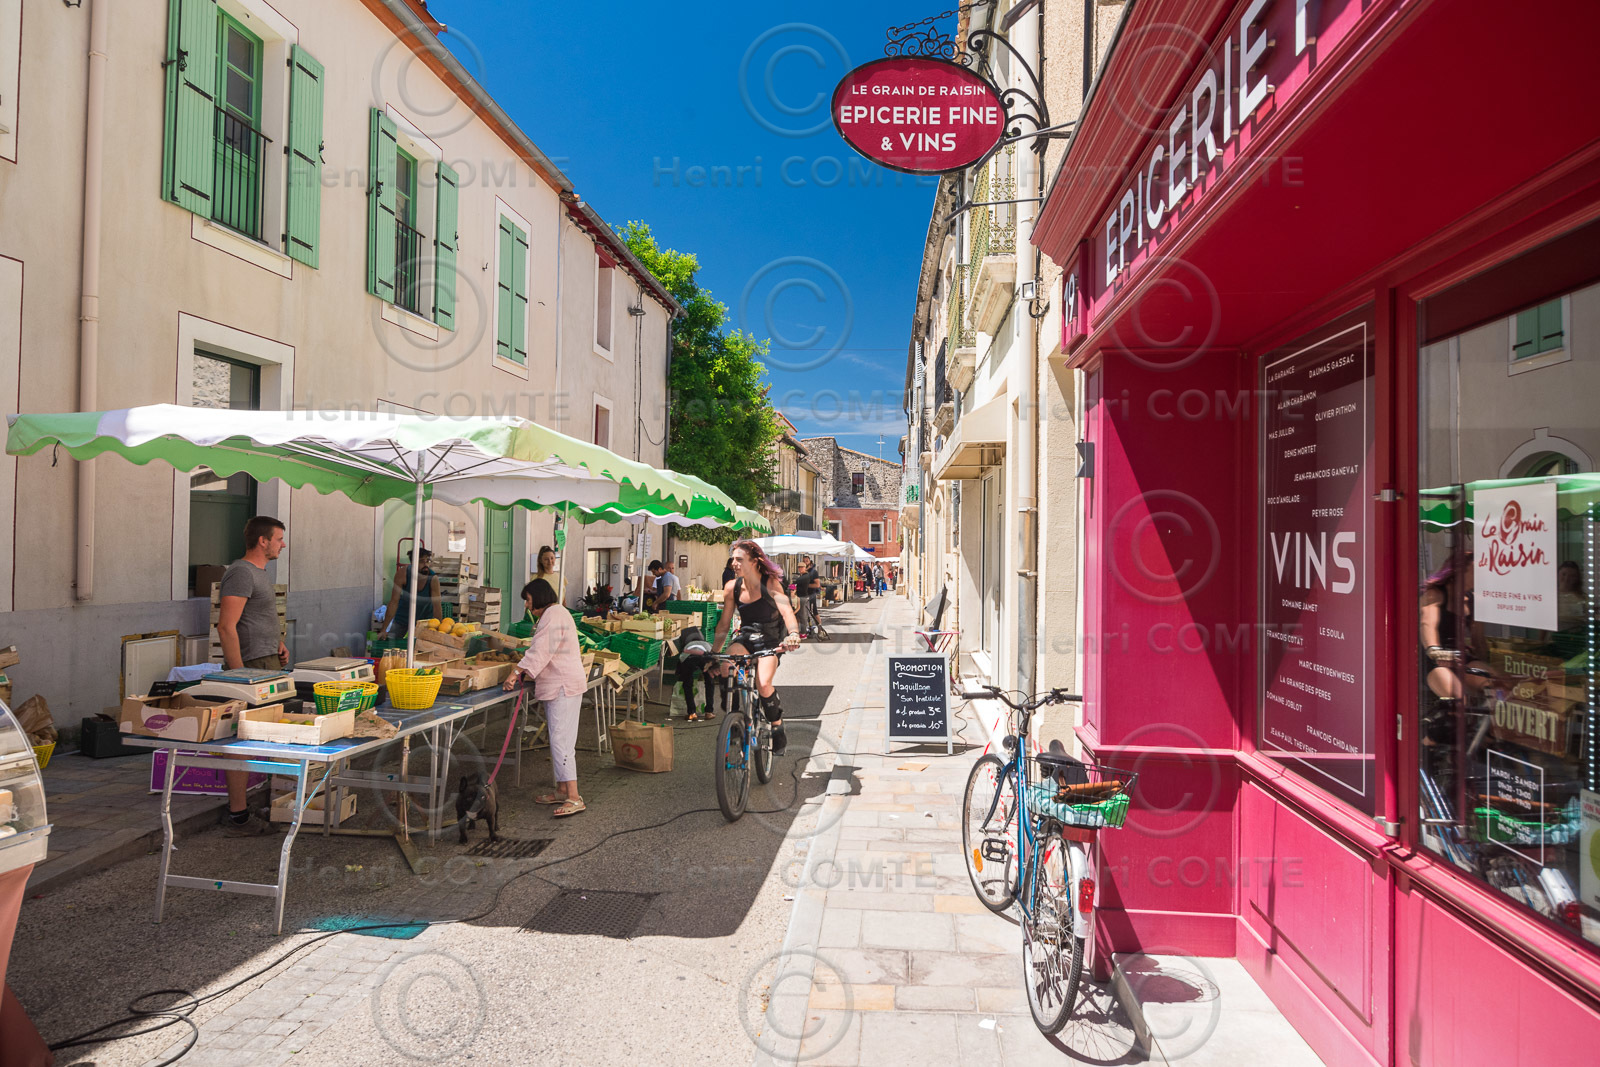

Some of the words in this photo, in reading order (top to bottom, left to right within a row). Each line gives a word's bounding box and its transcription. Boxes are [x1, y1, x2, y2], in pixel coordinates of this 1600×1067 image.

[852, 85, 868, 95] LE
[872, 85, 914, 96] GRAIN
[918, 86, 935, 96] DE
[940, 86, 986, 96] RAISIN
[840, 105, 940, 125] EPICERIE
[950, 106, 997, 125] FINE
[881, 136, 893, 151] &
[899, 132, 956, 152] VINS
[1106, 0, 1267, 286] EPICERIE
[1064, 272, 1076, 328] 19
[1274, 366, 1296, 380] GARANCE
[1308, 363, 1330, 378] DAUMAS
[1331, 354, 1355, 370] GASSAC
[1314, 408, 1334, 422] OLIVIER
[1336, 402, 1356, 416] PITHON
[1268, 430, 1278, 440] MAS
[1284, 448, 1296, 458] DENIS
[1298, 444, 1316, 456] MORTET
[1332, 464, 1358, 476] GANEVAT
[1312, 508, 1328, 518] PEYRE
[1329, 508, 1344, 516] ROSE
[1481, 512, 1497, 538] Le
[1270, 532, 1356, 594] VINS
[1478, 552, 1488, 568] de
[1488, 539, 1550, 576] Raisin
[1282, 598, 1302, 610] DOMAINE
[1302, 602, 1318, 612] JAMET
[1482, 590, 1508, 599] EPICERIE
[1508, 592, 1522, 600] FINE
[1527, 594, 1542, 602] VINS
[1320, 626, 1326, 636] LE
[1326, 628, 1344, 640] SOULA
[1298, 660, 1312, 670] MARC
[1313, 664, 1355, 684] KREYDENWEISS
[1504, 655, 1548, 680] Entrez
[1280, 674, 1286, 683] LA
[1286, 678, 1304, 691] GRANGE
[1305, 684, 1314, 695] DES
[1512, 684, 1535, 699] c'est
[1266, 690, 1284, 705] DOMAINE
[1285, 698, 1302, 712] JOBLOT
[1495, 700, 1559, 742] OUVERT
[1332, 738, 1358, 756] CHIDAINE
[1491, 768, 1510, 780] MARDI
[1515, 776, 1539, 791] SAMEDI
